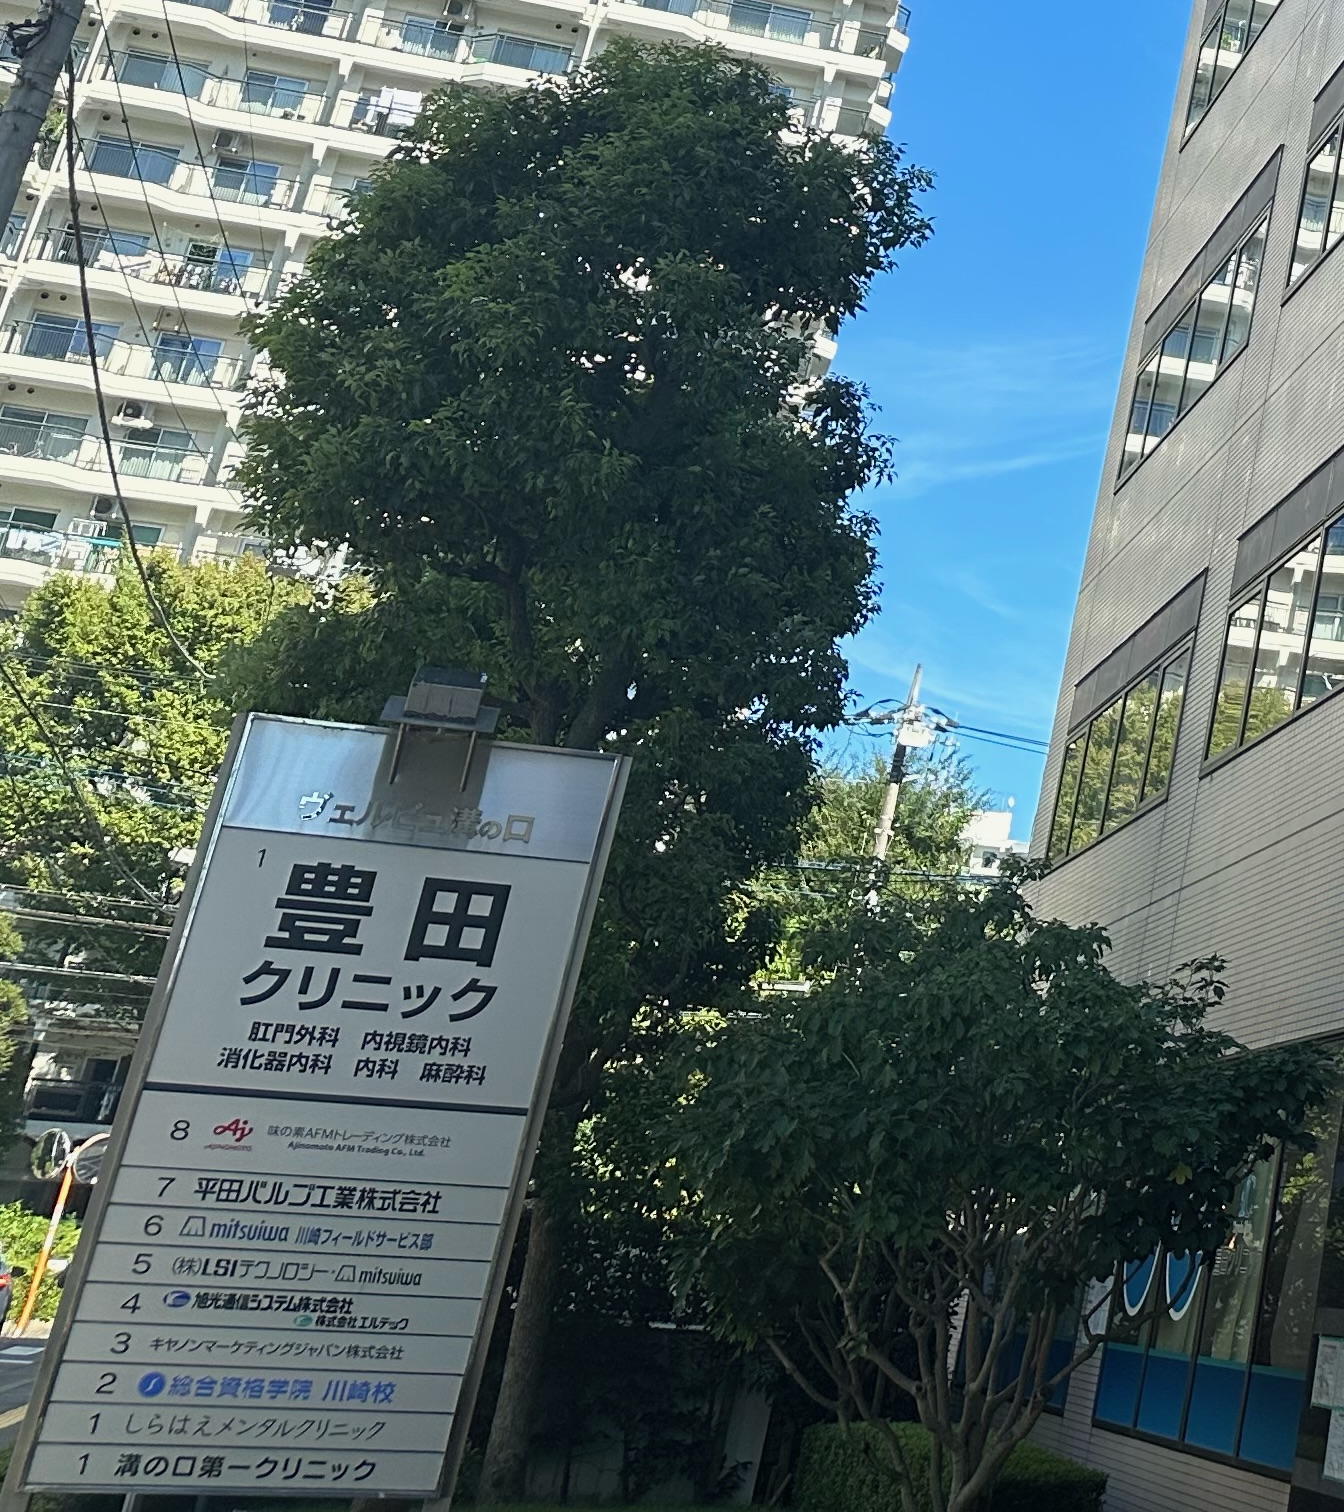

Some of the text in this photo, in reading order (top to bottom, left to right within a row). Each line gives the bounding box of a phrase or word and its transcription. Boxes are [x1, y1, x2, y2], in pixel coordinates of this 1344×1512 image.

[257, 848, 267, 868] 1
[263, 862, 512, 968] 豊田
[239, 960, 499, 1022] クリニック
[248, 1021, 472, 1057] 肛門外科 内視鏡内科
[217, 1047, 487, 1086] 消化器内科 内科 麻酔科
[170, 1119, 191, 1140] 8
[267, 1124, 452, 1149] 味の素AFMトレーディング株式会社
[157, 1176, 442, 1215] 7 平田バルブ工業株式会社
[144, 1215, 434, 1251] 6 mitsuiwa 川崎フィールドサービス部
[132, 1253, 153, 1274] 5
[358, 1266, 422, 1286] mitsuiwa
[120, 1292, 354, 1314] 4 旭光通信システム株式会社
[314, 1315, 409, 1330] 株式会社エルテック
[110, 1332, 131, 1354] 3
[95, 1372, 398, 1404] 2 総合資格学院 川崎校
[89, 1412, 387, 1440] 1 しらはえメンタルクリニック
[78, 1453, 377, 1482] 1 溝の口第一クリニック
